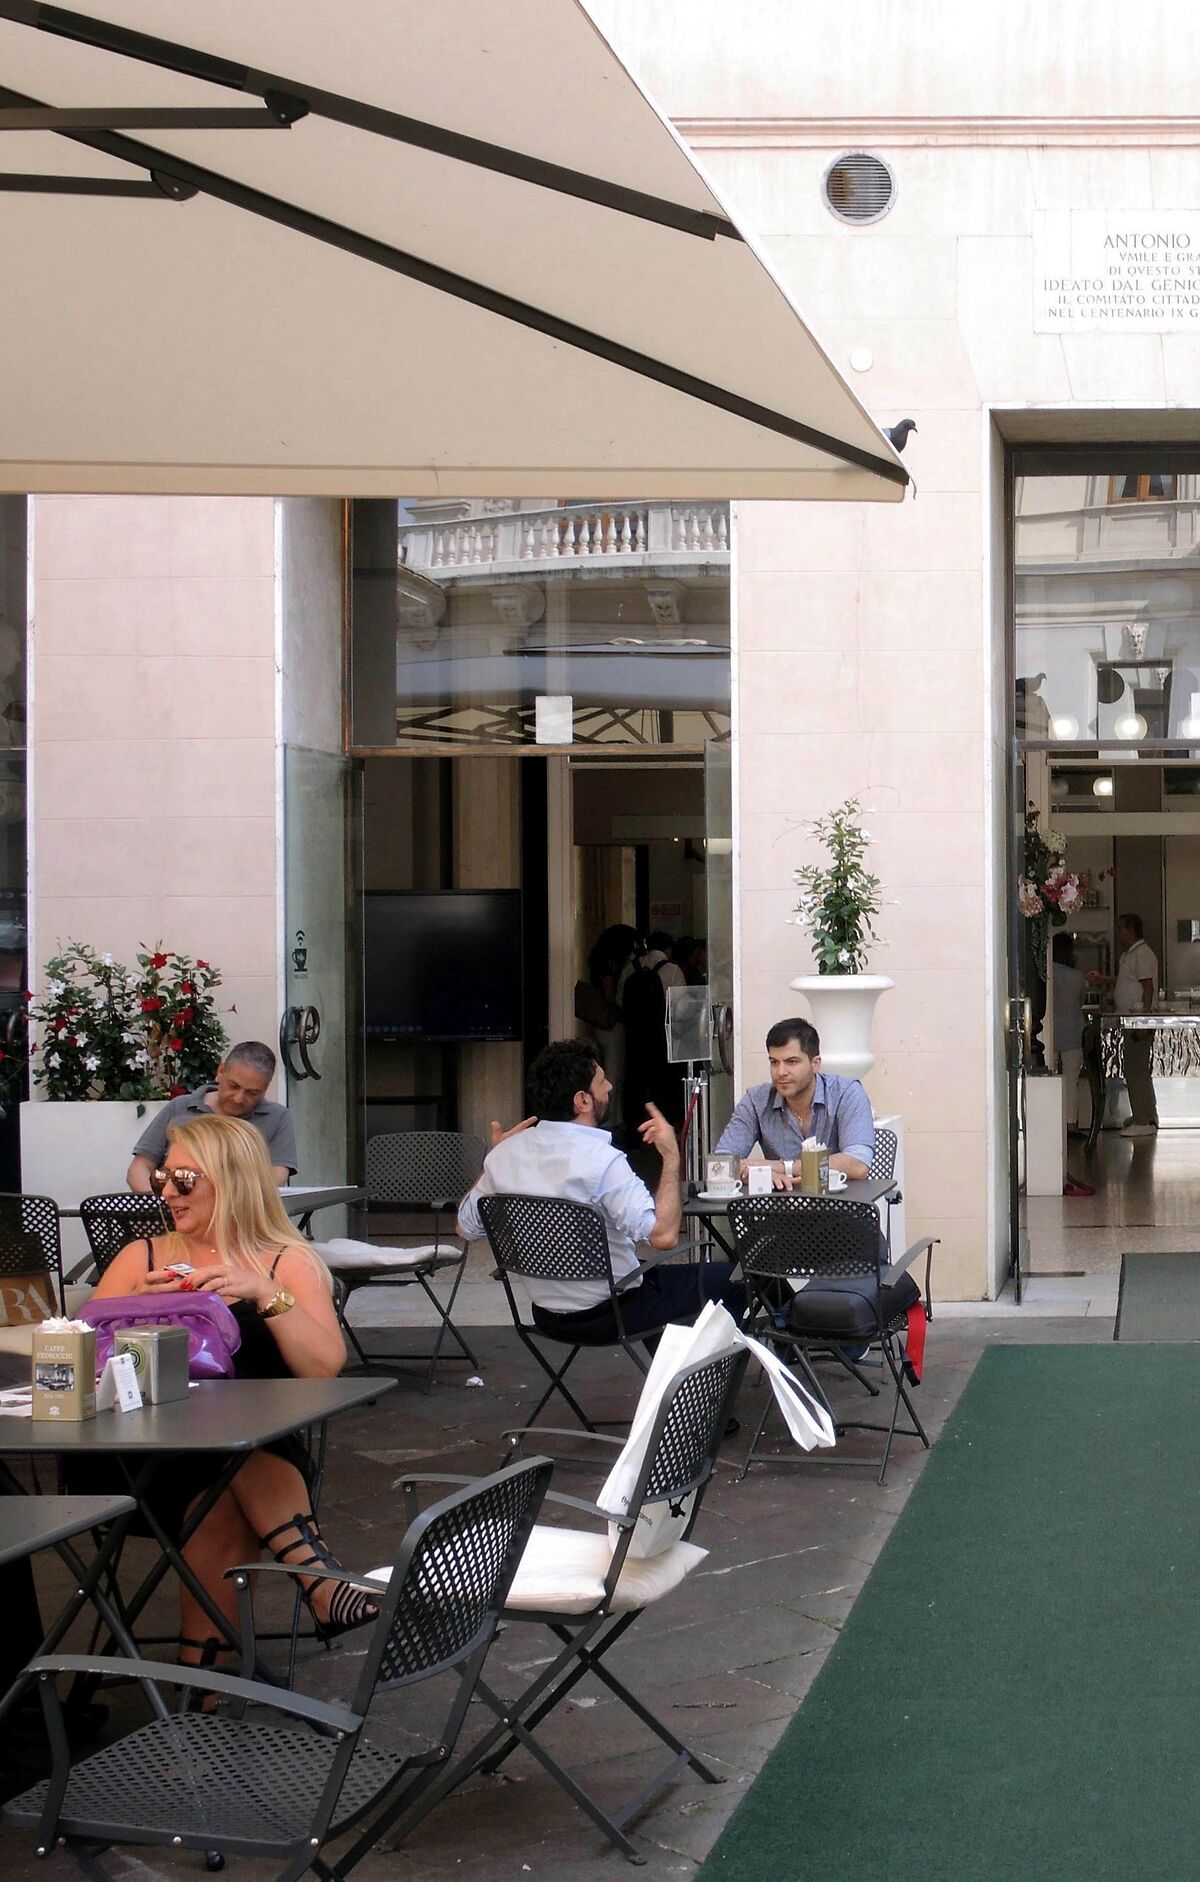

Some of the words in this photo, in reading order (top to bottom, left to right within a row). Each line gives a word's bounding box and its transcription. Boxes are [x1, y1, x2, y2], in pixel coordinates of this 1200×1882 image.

[1104, 233, 1190, 249] ANTONIO
[1120, 252, 1157, 262] VMILE
[1165, 252, 1171, 262] E
[1109, 266, 1121, 275] DI
[1128, 266, 1180, 277] QVESTO
[1044, 280, 1103, 291] IDEATO
[1113, 280, 1143, 291] DAL
[1059, 295, 1070, 304] IL
[1077, 295, 1145, 304] COMITATO
[1049, 308, 1074, 318] NEL
[1081, 308, 1164, 318] CENTENARIO
[1172, 308, 1183, 317] IX
[0, 1282, 51, 1322] RA
